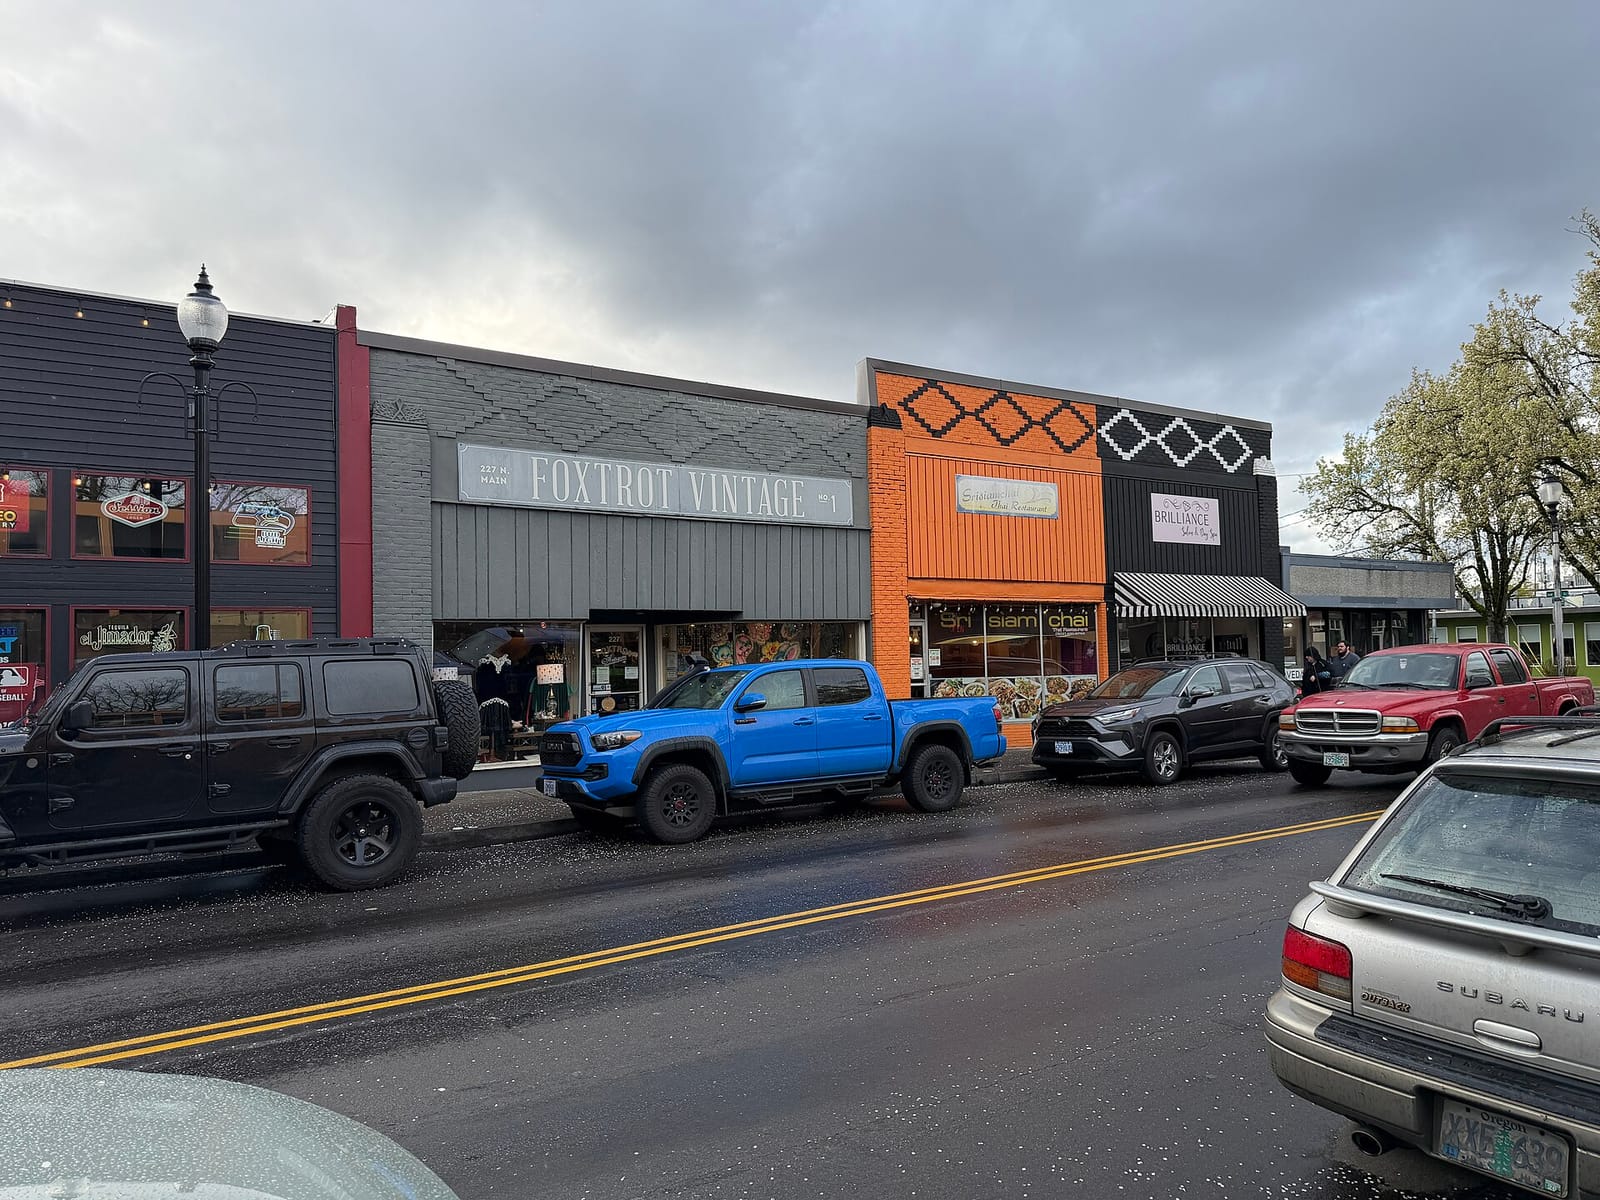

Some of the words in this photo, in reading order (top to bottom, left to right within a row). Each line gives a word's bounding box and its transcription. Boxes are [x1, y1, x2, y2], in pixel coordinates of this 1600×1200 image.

[480, 464, 495, 473] 227
[499, 466, 510, 475] N.
[480, 475, 507, 485] MAIN
[531, 456, 672, 509] FOXTROT
[688, 471, 805, 518] VINTAGE
[109, 501, 161, 514] Session
[991, 499, 1009, 510] Thai
[1011, 501, 1048, 513] Restaurant
[1154, 510, 1209, 527] BRILLIANCE
[940, 611, 972, 629] Sri
[988, 611, 1037, 628] siam
[1048, 611, 1089, 627] chai
[80, 631, 92, 646] el
[92, 625, 154, 651] Jimador
[1166, 644, 1206, 652] BRILLIANCE
[1360, 991, 1411, 1013] OUTBACK
[1436, 980, 1584, 1023] SUBARU
[1480, 1111, 1528, 1134] Oregon
